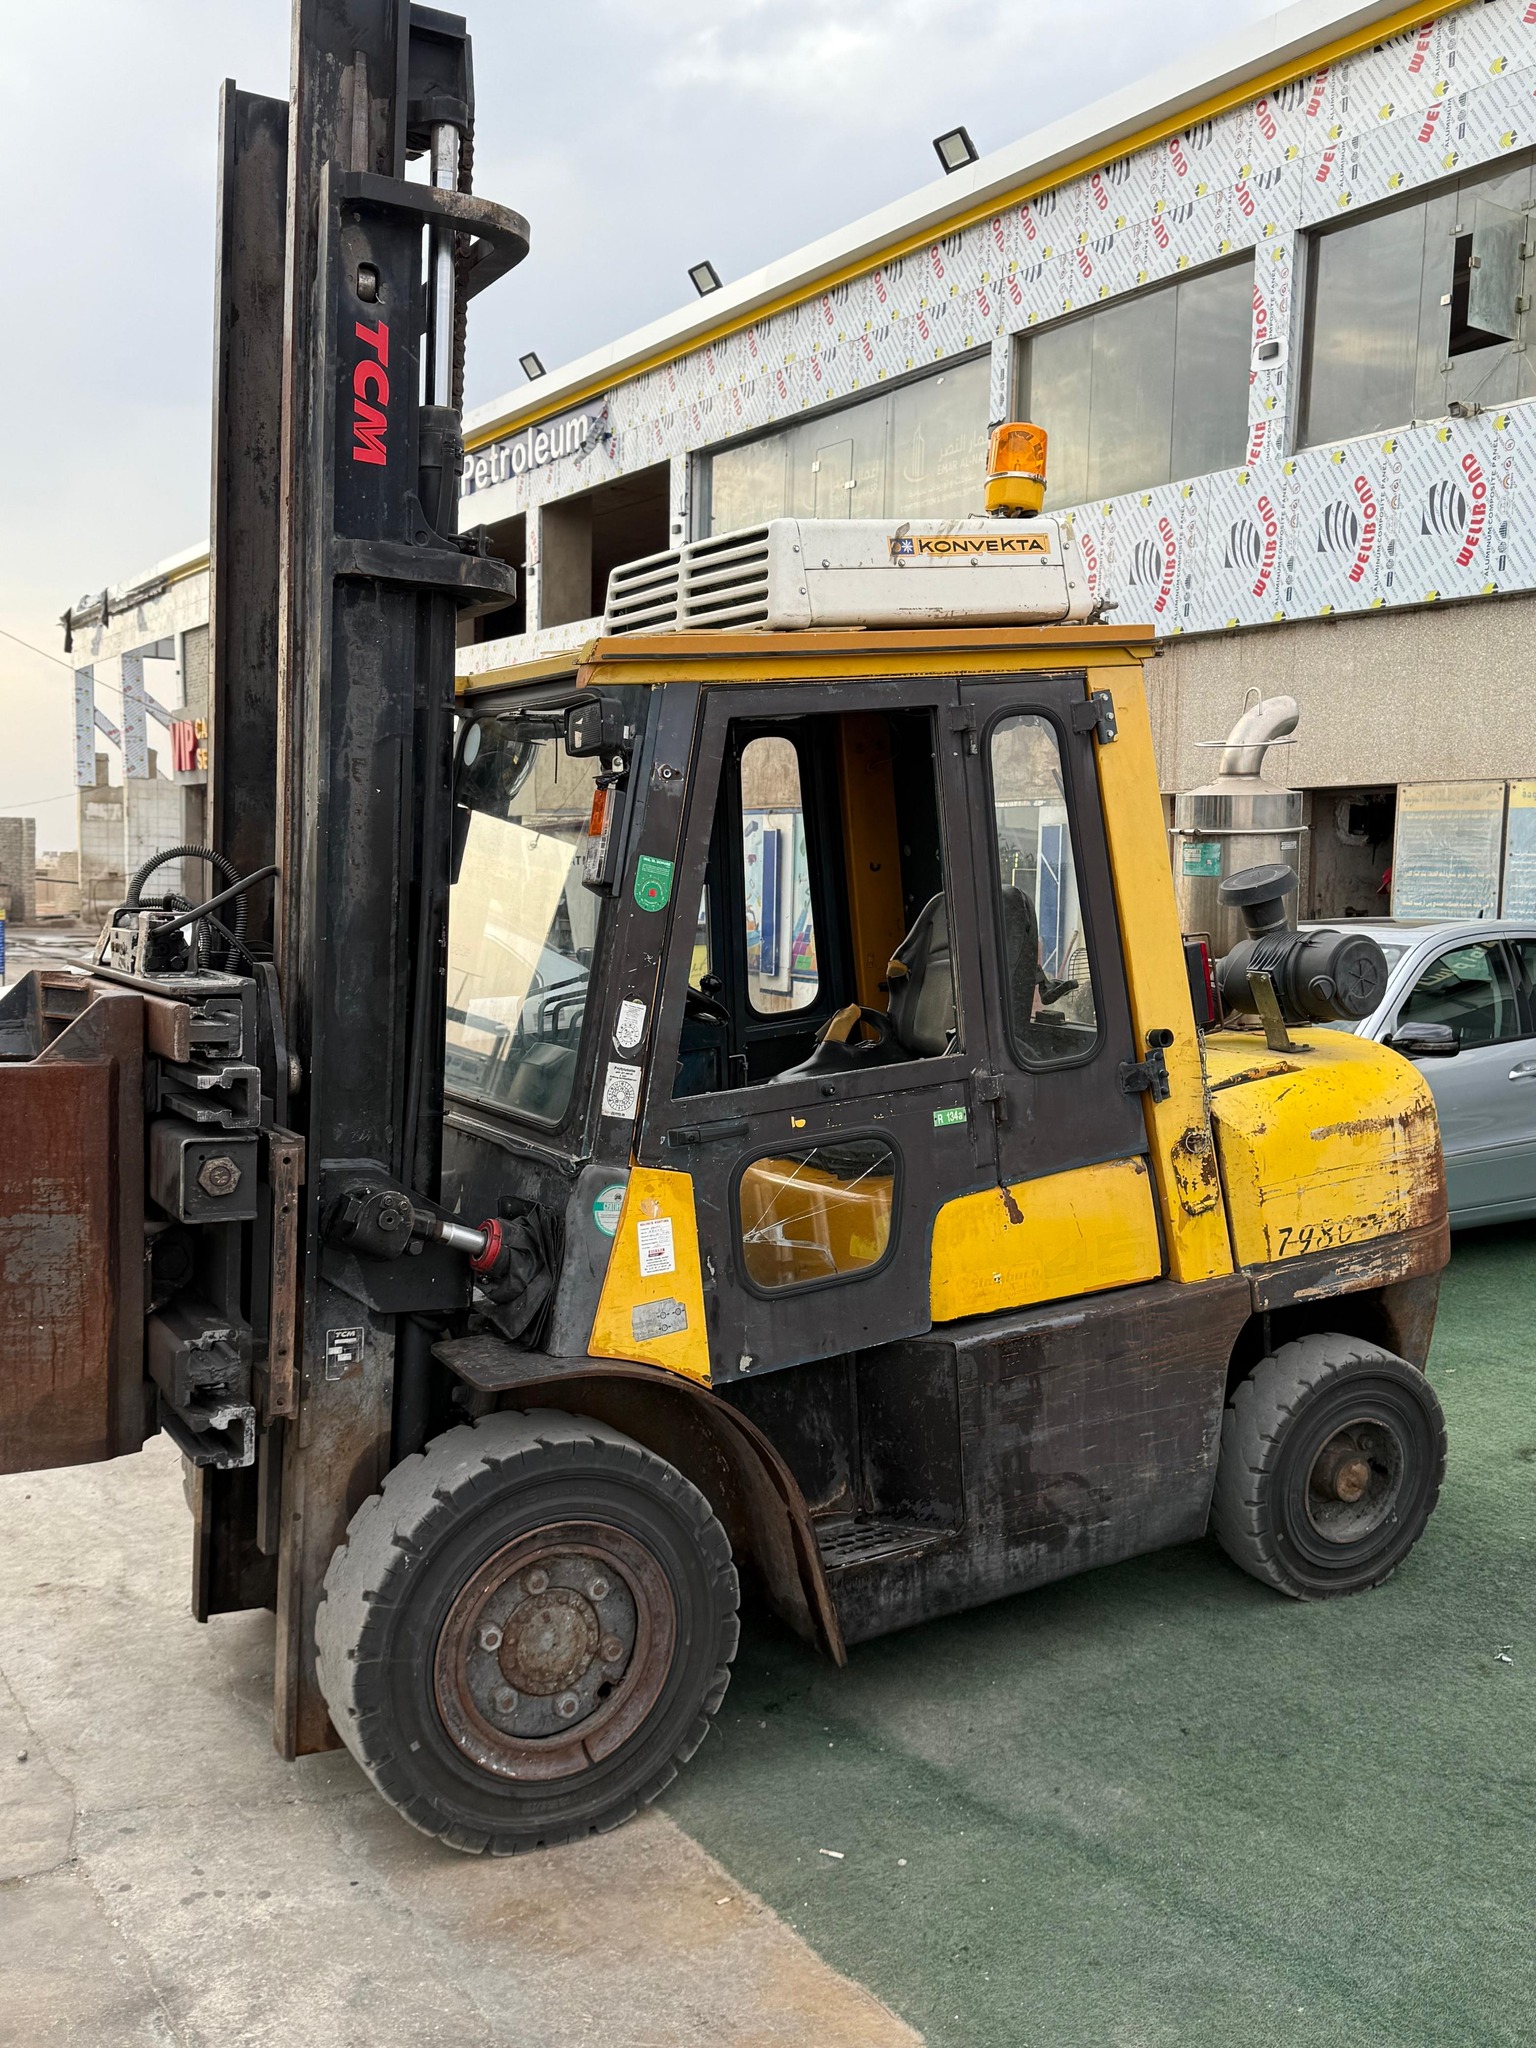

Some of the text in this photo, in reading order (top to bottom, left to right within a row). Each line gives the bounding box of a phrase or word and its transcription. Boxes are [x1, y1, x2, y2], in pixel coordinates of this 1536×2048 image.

[353, 319, 390, 466] TCM
[461, 414, 588, 496] Petroleum
[959, 450, 987, 469] AL-NA
[918, 537, 1044, 553] KONVEKTA
[1252, 495, 1278, 598] WELLBOND
[1348, 475, 1377, 583] WELLBOND
[1378, 492, 1386, 544] COMPOSITE
[1456, 453, 1487, 567] WELLBOND
[1484, 438, 1499, 577] ALUMINUM COMPOSITE PANEL
[1153, 517, 1177, 613] WELLBOND
[1173, 579, 1181, 621] ALUMINUM
[937, 1110, 963, 1124] R 134a
[335, 1330, 356, 1338] TCM
